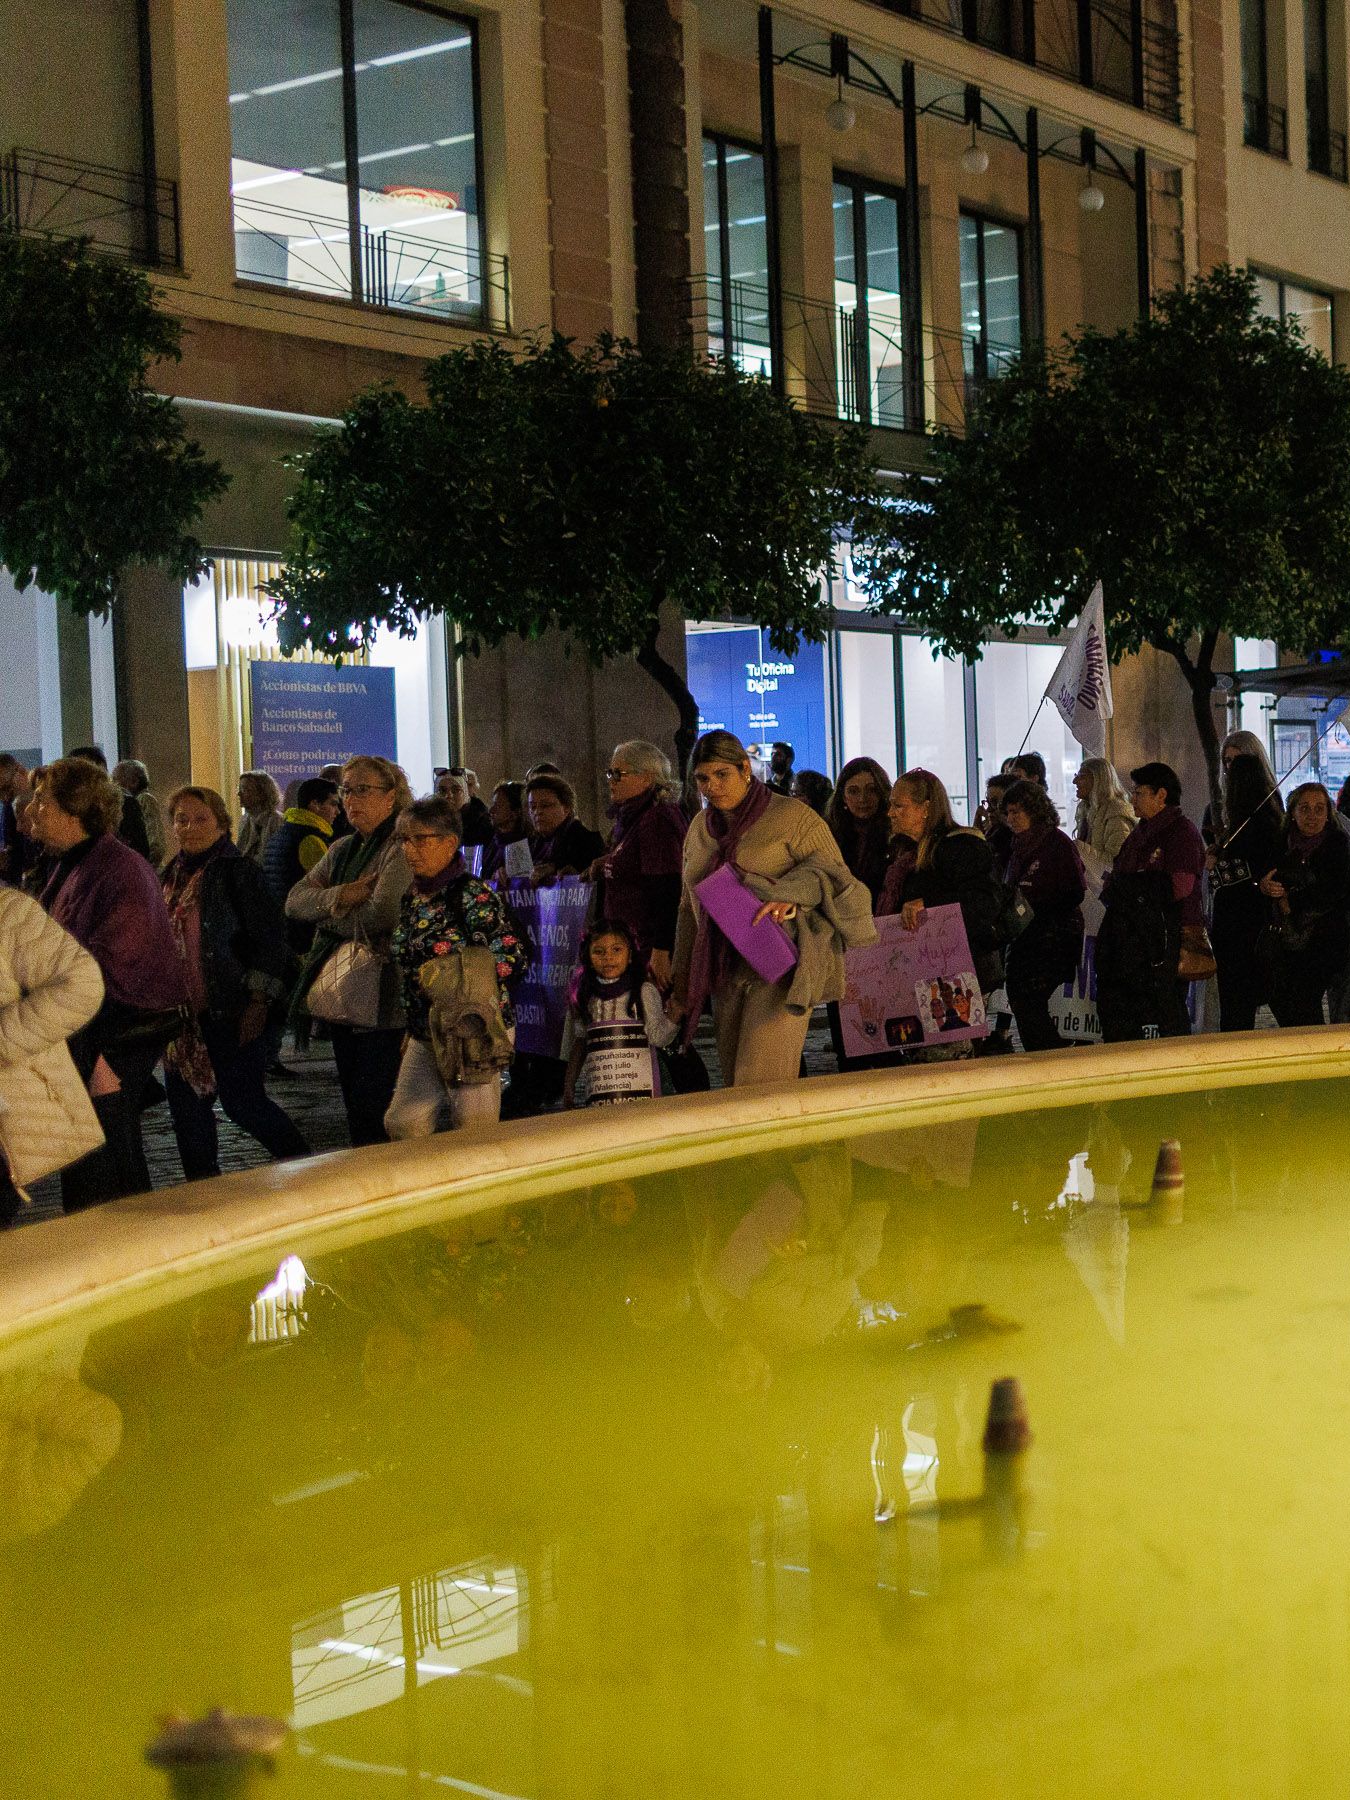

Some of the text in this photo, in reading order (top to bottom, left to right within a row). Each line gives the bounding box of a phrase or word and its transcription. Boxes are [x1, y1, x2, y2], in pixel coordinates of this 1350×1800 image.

[746, 662, 795, 676] Tu Oficina
[260, 680, 367, 694] Accionistas de BBVA
[747, 678, 778, 694] Digital
[262, 708, 337, 720] Accionistas de
[262, 722, 343, 733] Banco Sabadell
[264, 764, 305, 774] nuestro
[1064, 1012, 1079, 1031] de
[595, 1051, 634, 1062] apuñalada
[615, 1062, 631, 1070] julio
[615, 1072, 638, 1080] pareja
[594, 1082, 632, 1092] (Valencia)
